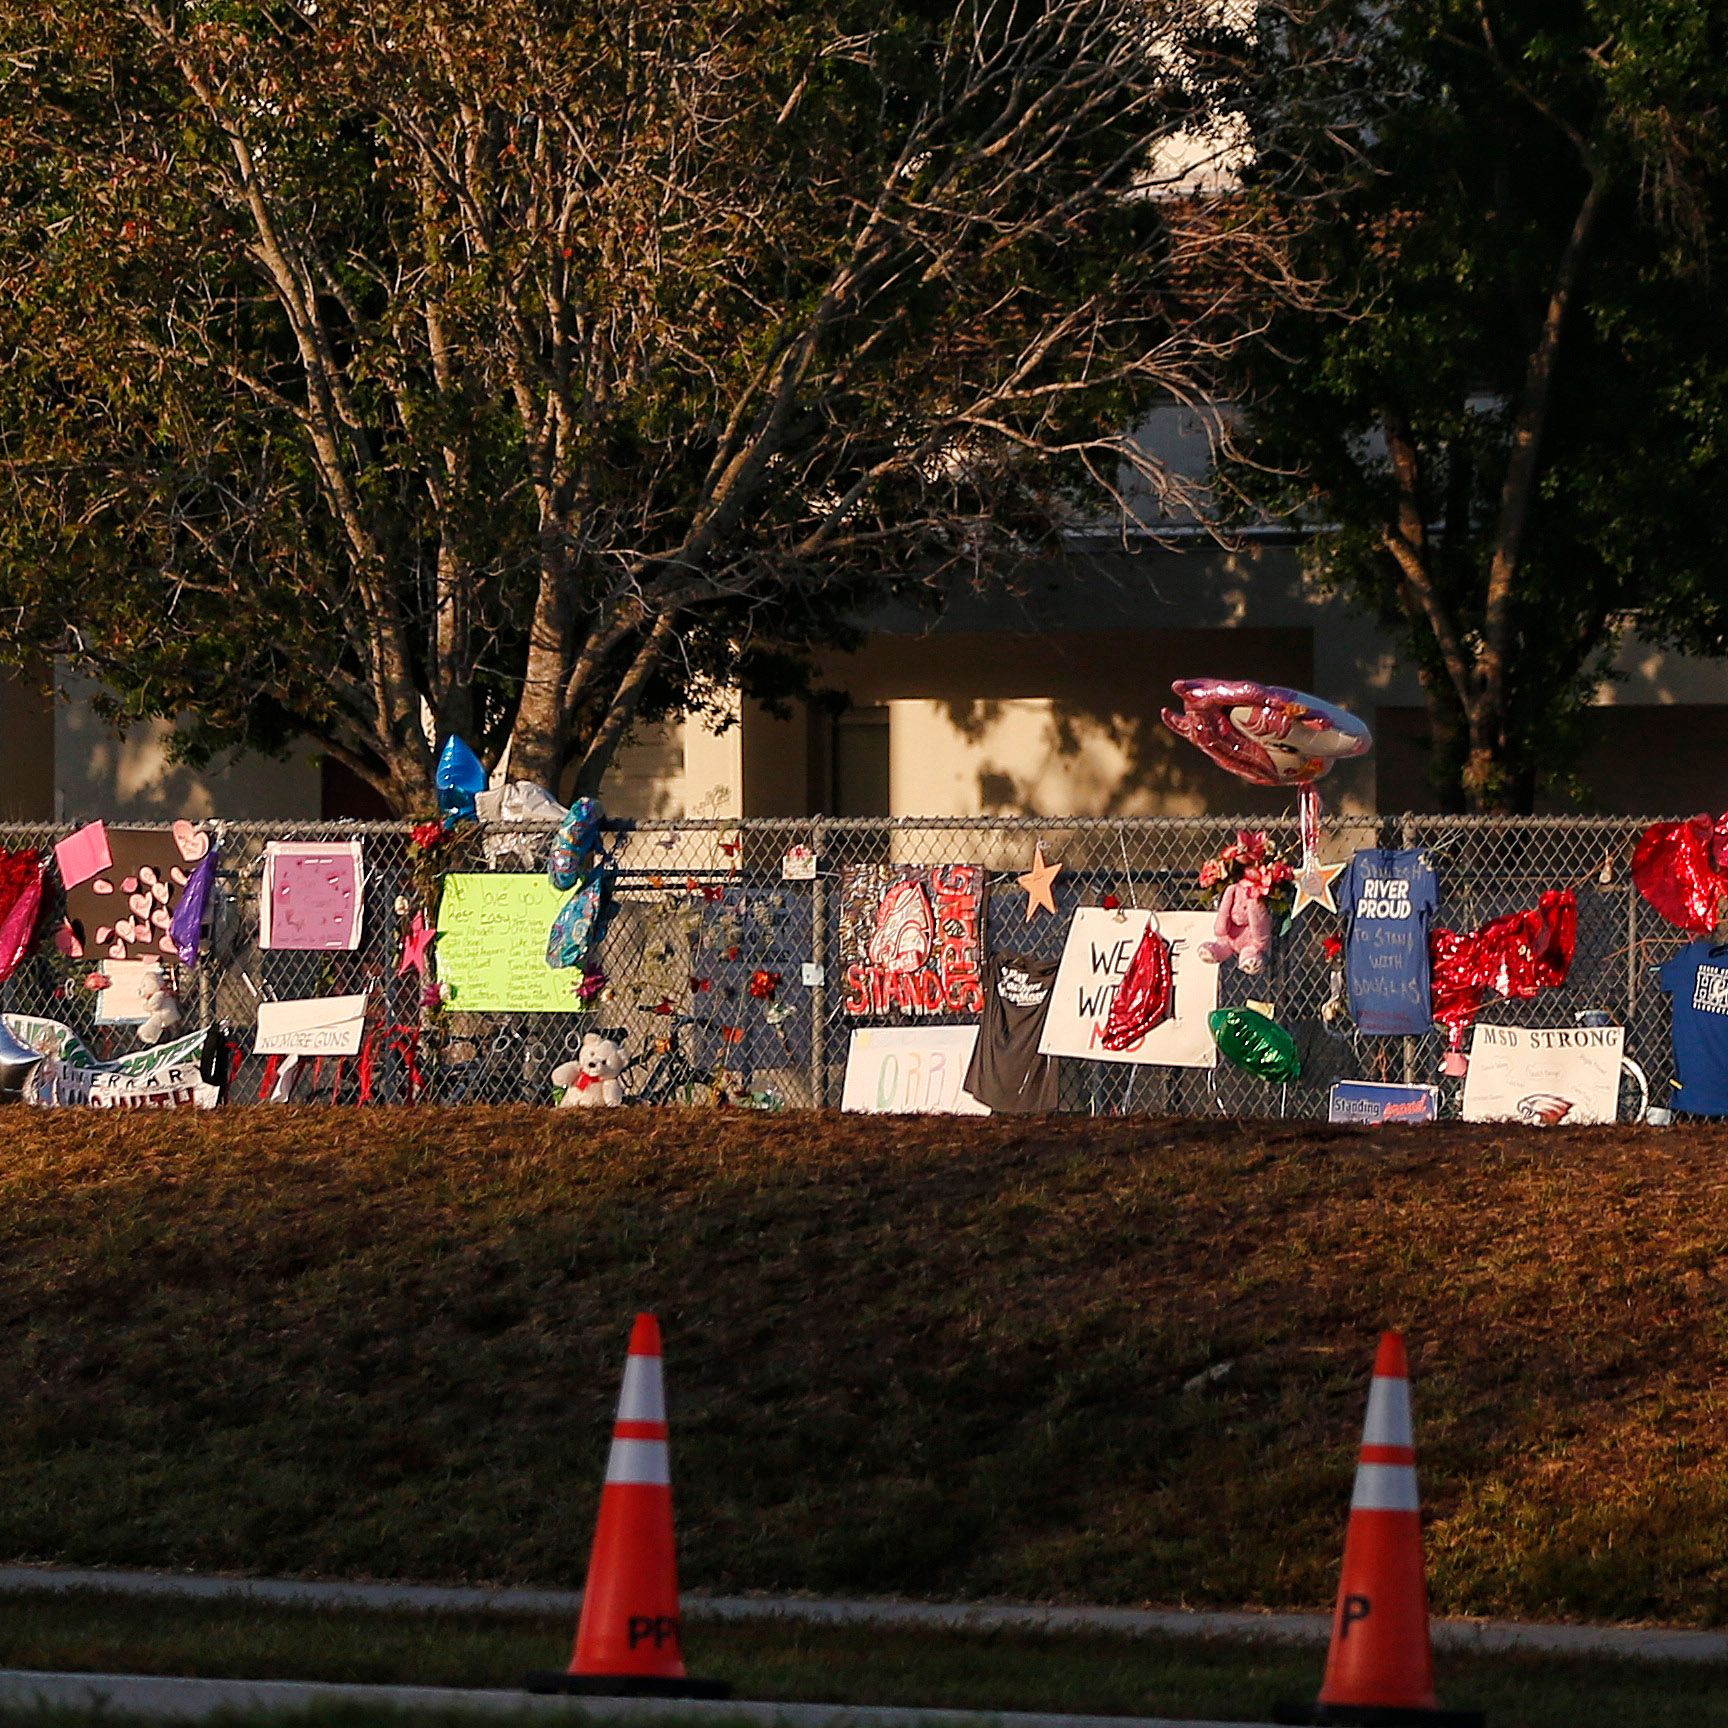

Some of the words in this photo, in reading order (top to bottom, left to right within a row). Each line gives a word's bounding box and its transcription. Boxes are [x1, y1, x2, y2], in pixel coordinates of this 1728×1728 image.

[1363, 879, 1410, 900] RIVER
[1356, 898, 1412, 920] PROUD
[846, 964, 946, 1015] STAND
[313, 1031, 351, 1048] GUNS
[1483, 1027, 1519, 1048] MSD
[1529, 1028, 1619, 1049] STRONG
[1333, 1096, 1381, 1117] Standing
